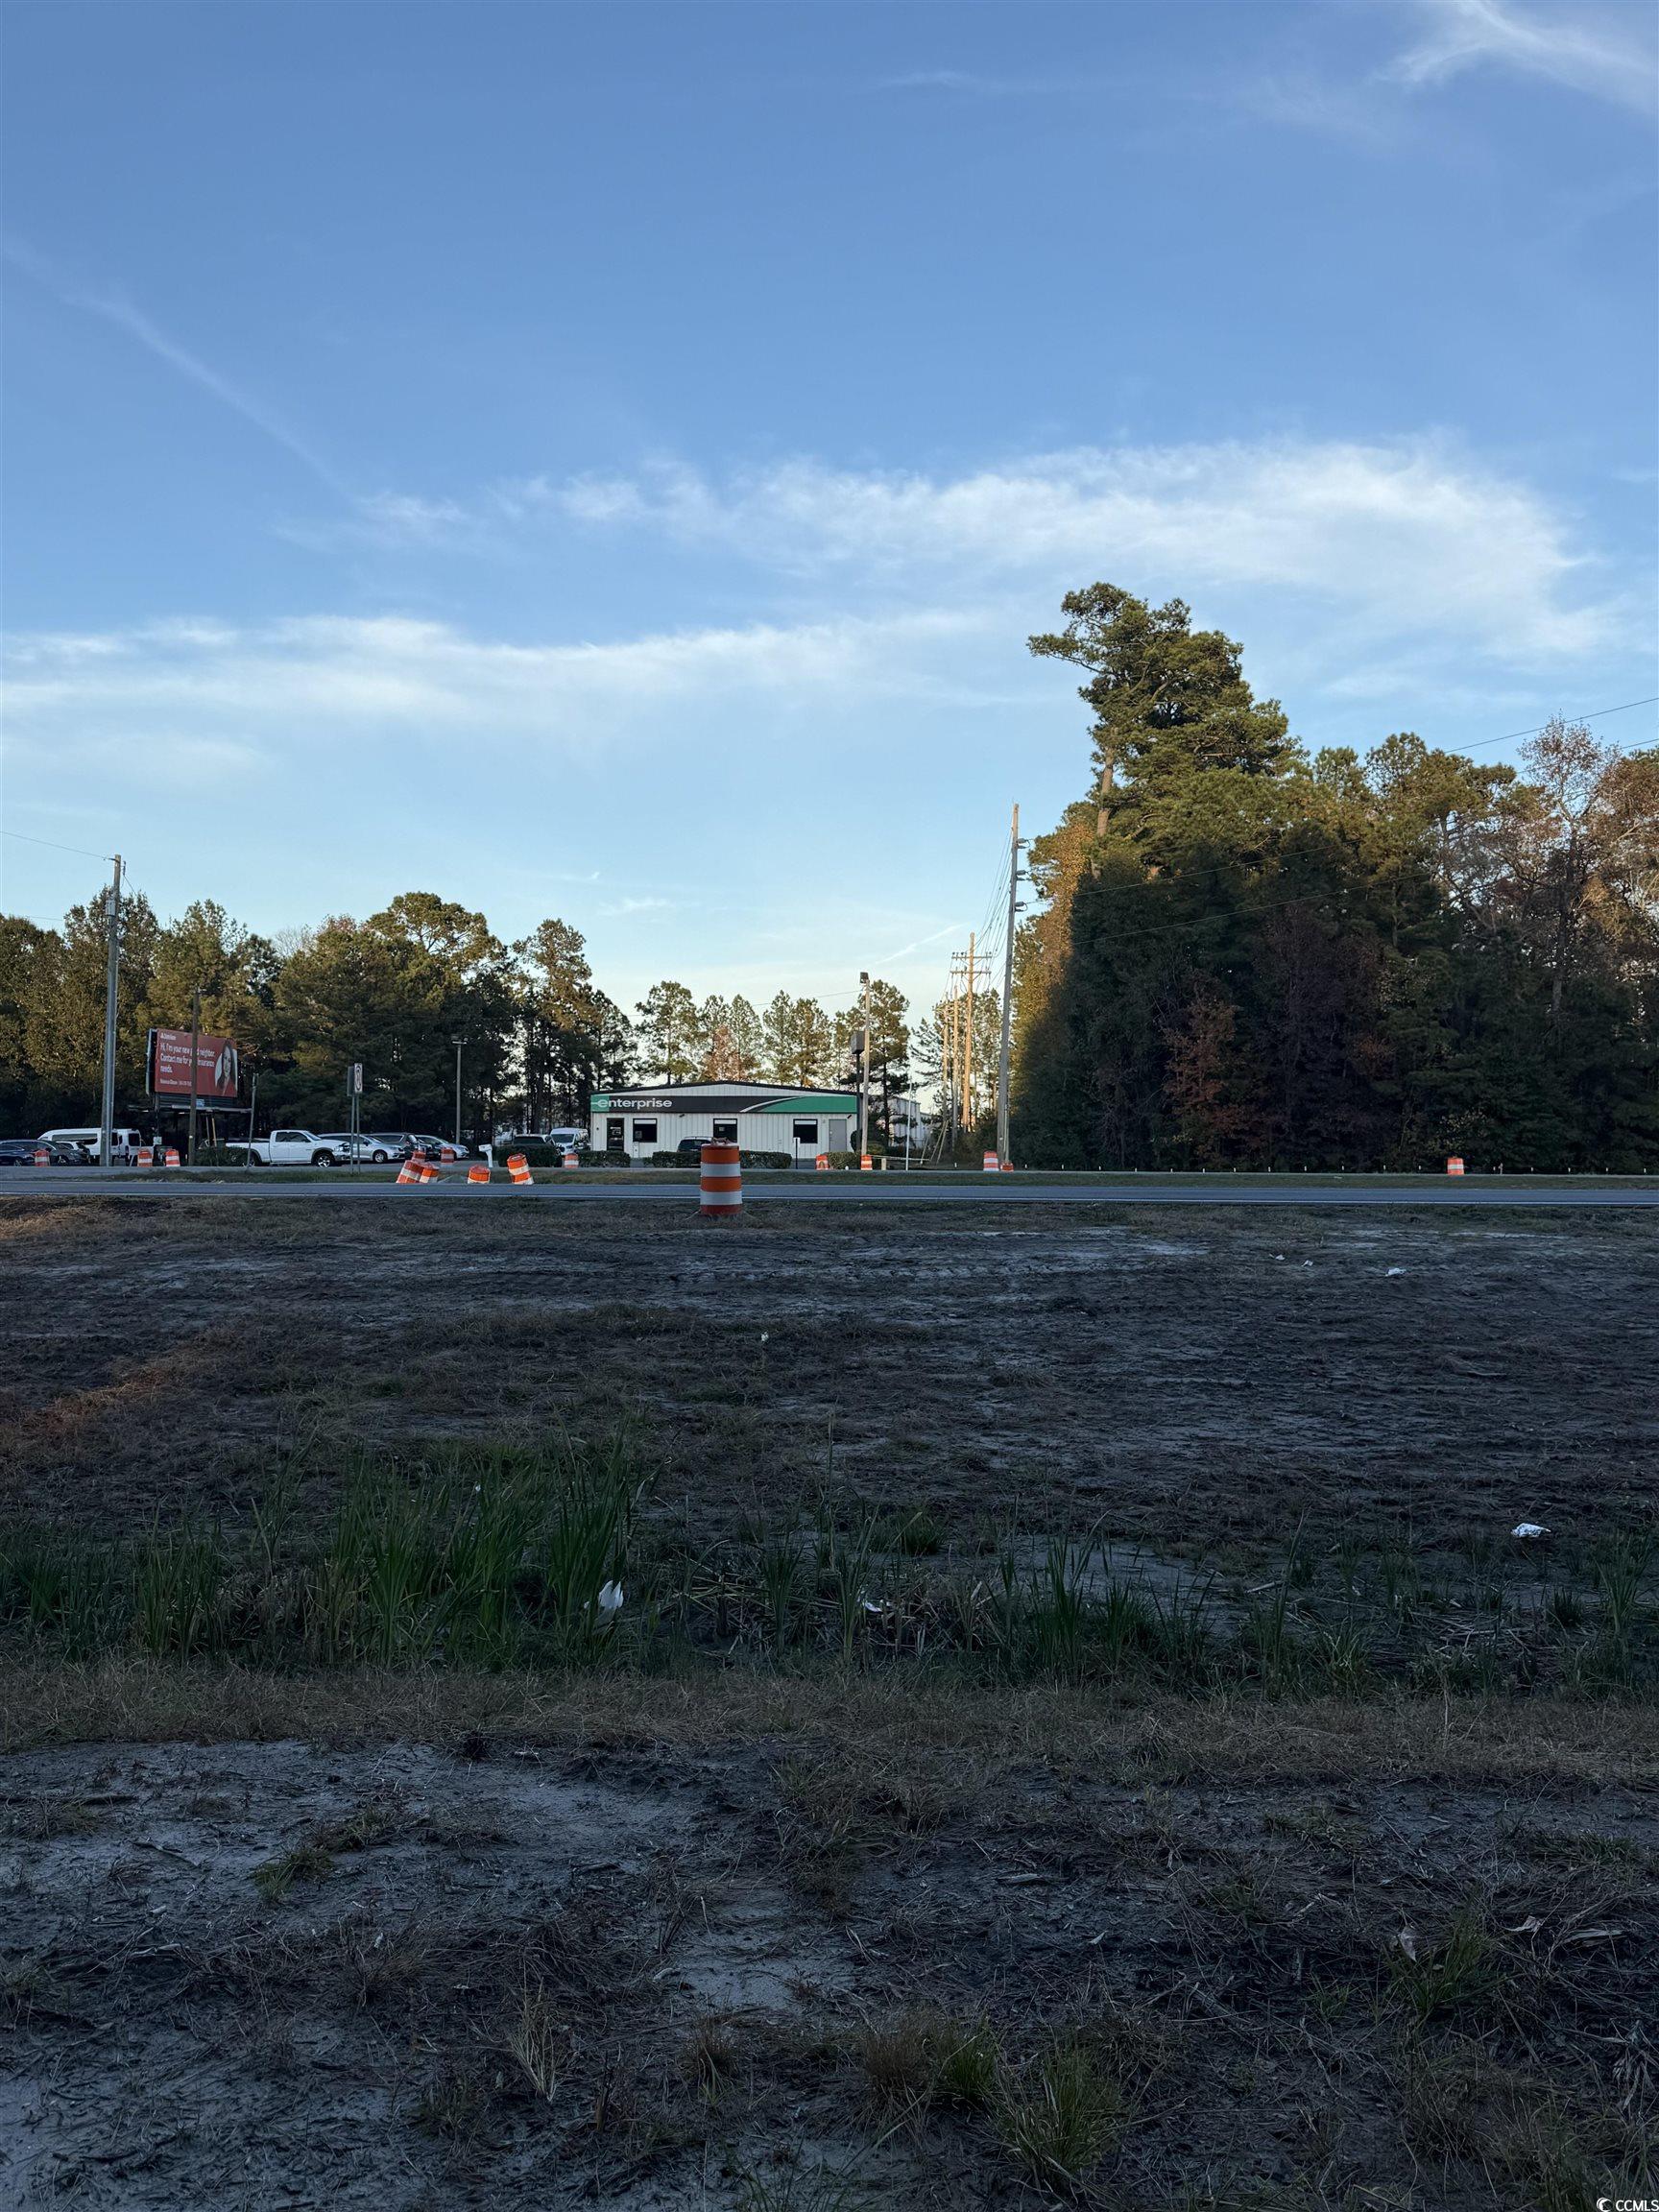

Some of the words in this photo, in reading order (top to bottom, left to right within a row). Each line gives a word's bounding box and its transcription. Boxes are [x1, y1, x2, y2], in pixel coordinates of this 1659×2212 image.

[173, 1046, 181, 1054] your
[160, 1053, 176, 1062] Contact
[596, 1097, 672, 1110] enterprise
